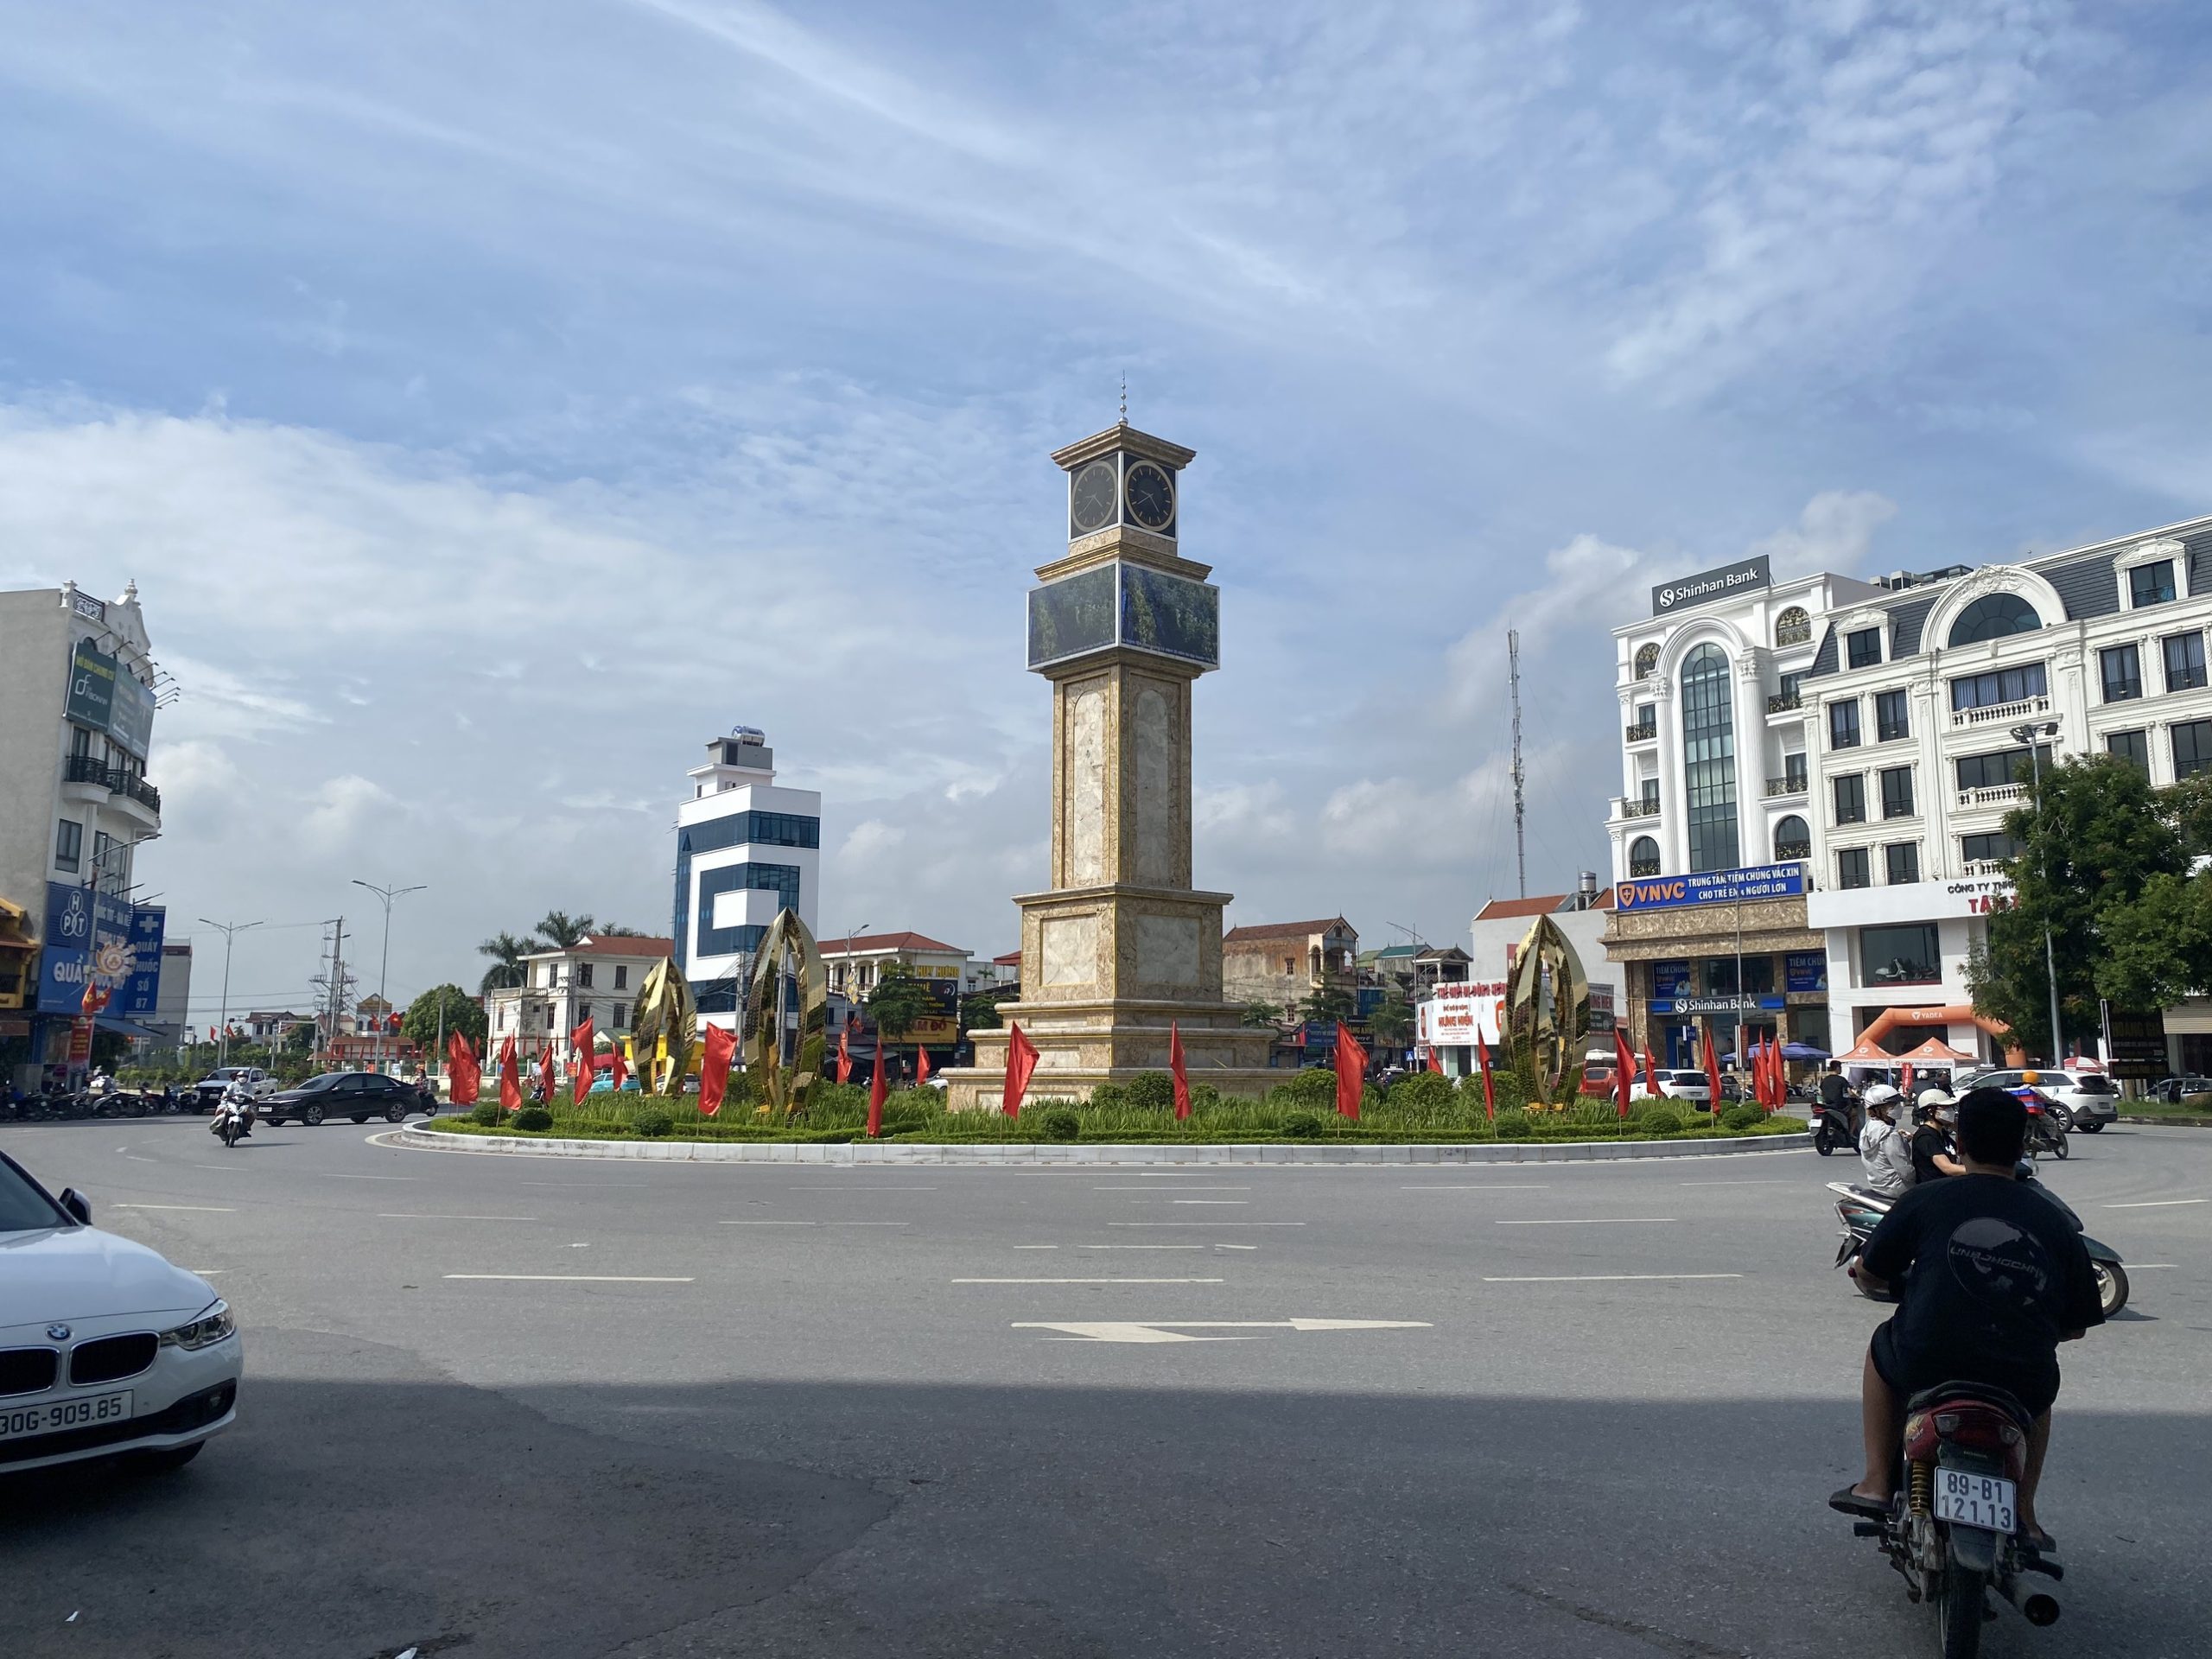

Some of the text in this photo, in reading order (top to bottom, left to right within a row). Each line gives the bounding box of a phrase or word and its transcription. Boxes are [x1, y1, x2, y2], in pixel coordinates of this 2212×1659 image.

[1676, 568, 1758, 601] Shinhan Bank
[1688, 877, 1712, 887] TRUNG
[1728, 871, 1745, 883] TIÊM
[1746, 868, 1770, 881] CHỦNG
[1772, 865, 1786, 879] VẮC
[1786, 867, 1799, 877] XIN
[1637, 881, 1685, 902] VNVC
[1699, 890, 1713, 899] CHO
[1714, 886, 1727, 898] TRẺ
[1745, 881, 1770, 895] NGƯỜI
[1771, 880, 1786, 893] LỚN
[1948, 883, 1974, 893] CÔNG
[1977, 882, 1989, 892] TY
[134, 957, 158, 972] HUỐC
[1807, 955, 1826, 966] CHỦN
[136, 998, 148, 1009] 87
[1688, 1000, 1728, 1010] Shinhan
[1947, 1472, 2003, 1503] 89-B1
[1941, 1494, 2012, 1529] 121.13
